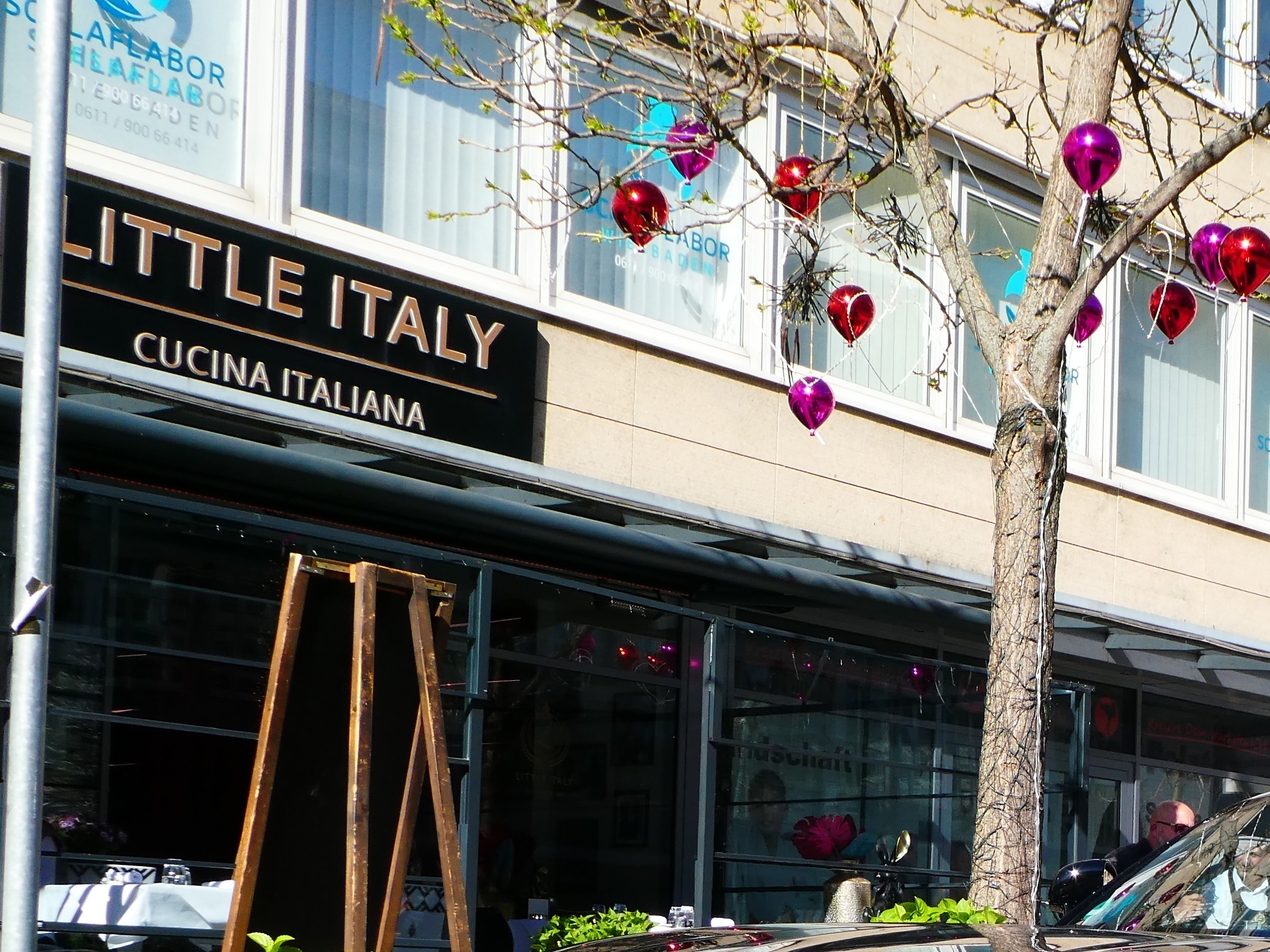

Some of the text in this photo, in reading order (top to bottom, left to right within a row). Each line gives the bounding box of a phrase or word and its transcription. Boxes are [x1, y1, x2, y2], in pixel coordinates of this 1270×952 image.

[63, 193, 505, 370] LITTLE ITALY
[133, 332, 426, 431] CUCINA ITALIANA
